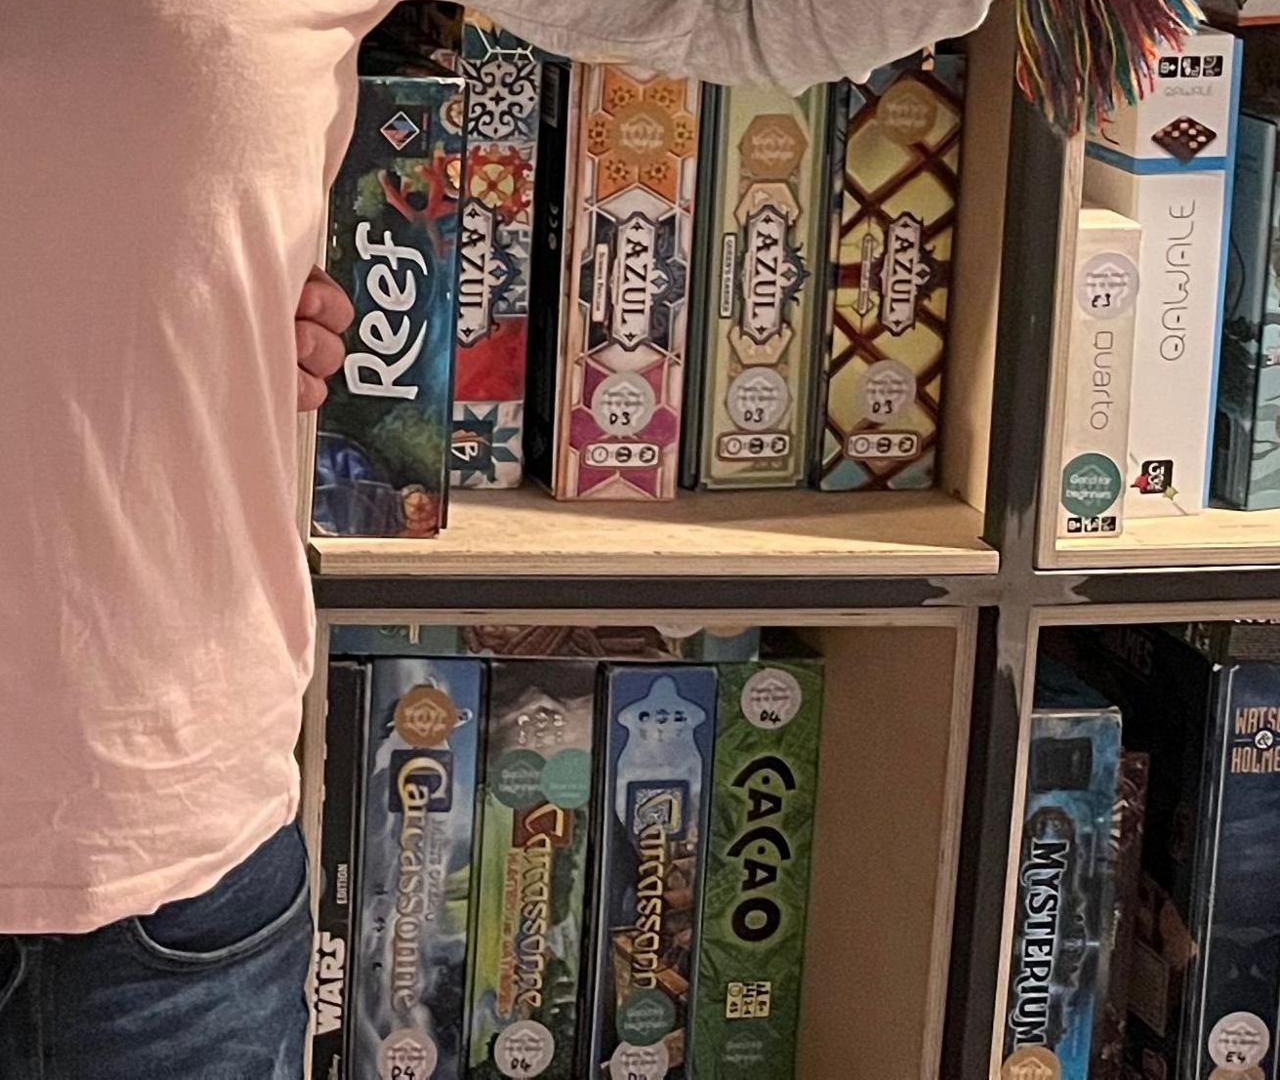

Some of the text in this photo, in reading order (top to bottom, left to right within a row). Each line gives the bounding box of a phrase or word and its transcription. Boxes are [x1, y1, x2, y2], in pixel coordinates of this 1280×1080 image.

[342, 220, 430, 402] Reef
[457, 224, 487, 319] AZUL
[621, 236, 650, 326] AZUL
[752, 229, 781, 318] AZUL
[888, 234, 916, 316] AZUL
[336, 863, 348, 905] EDITION
[392, 756, 450, 1012] Carcassonne
[514, 802, 565, 1008] Carcassonne
[631, 792, 681, 990] Carcassonn
[725, 755, 797, 943] CACAO
[315, 931, 346, 1036] WARS
[1014, 837, 1070, 1050] MYSTERIUM
